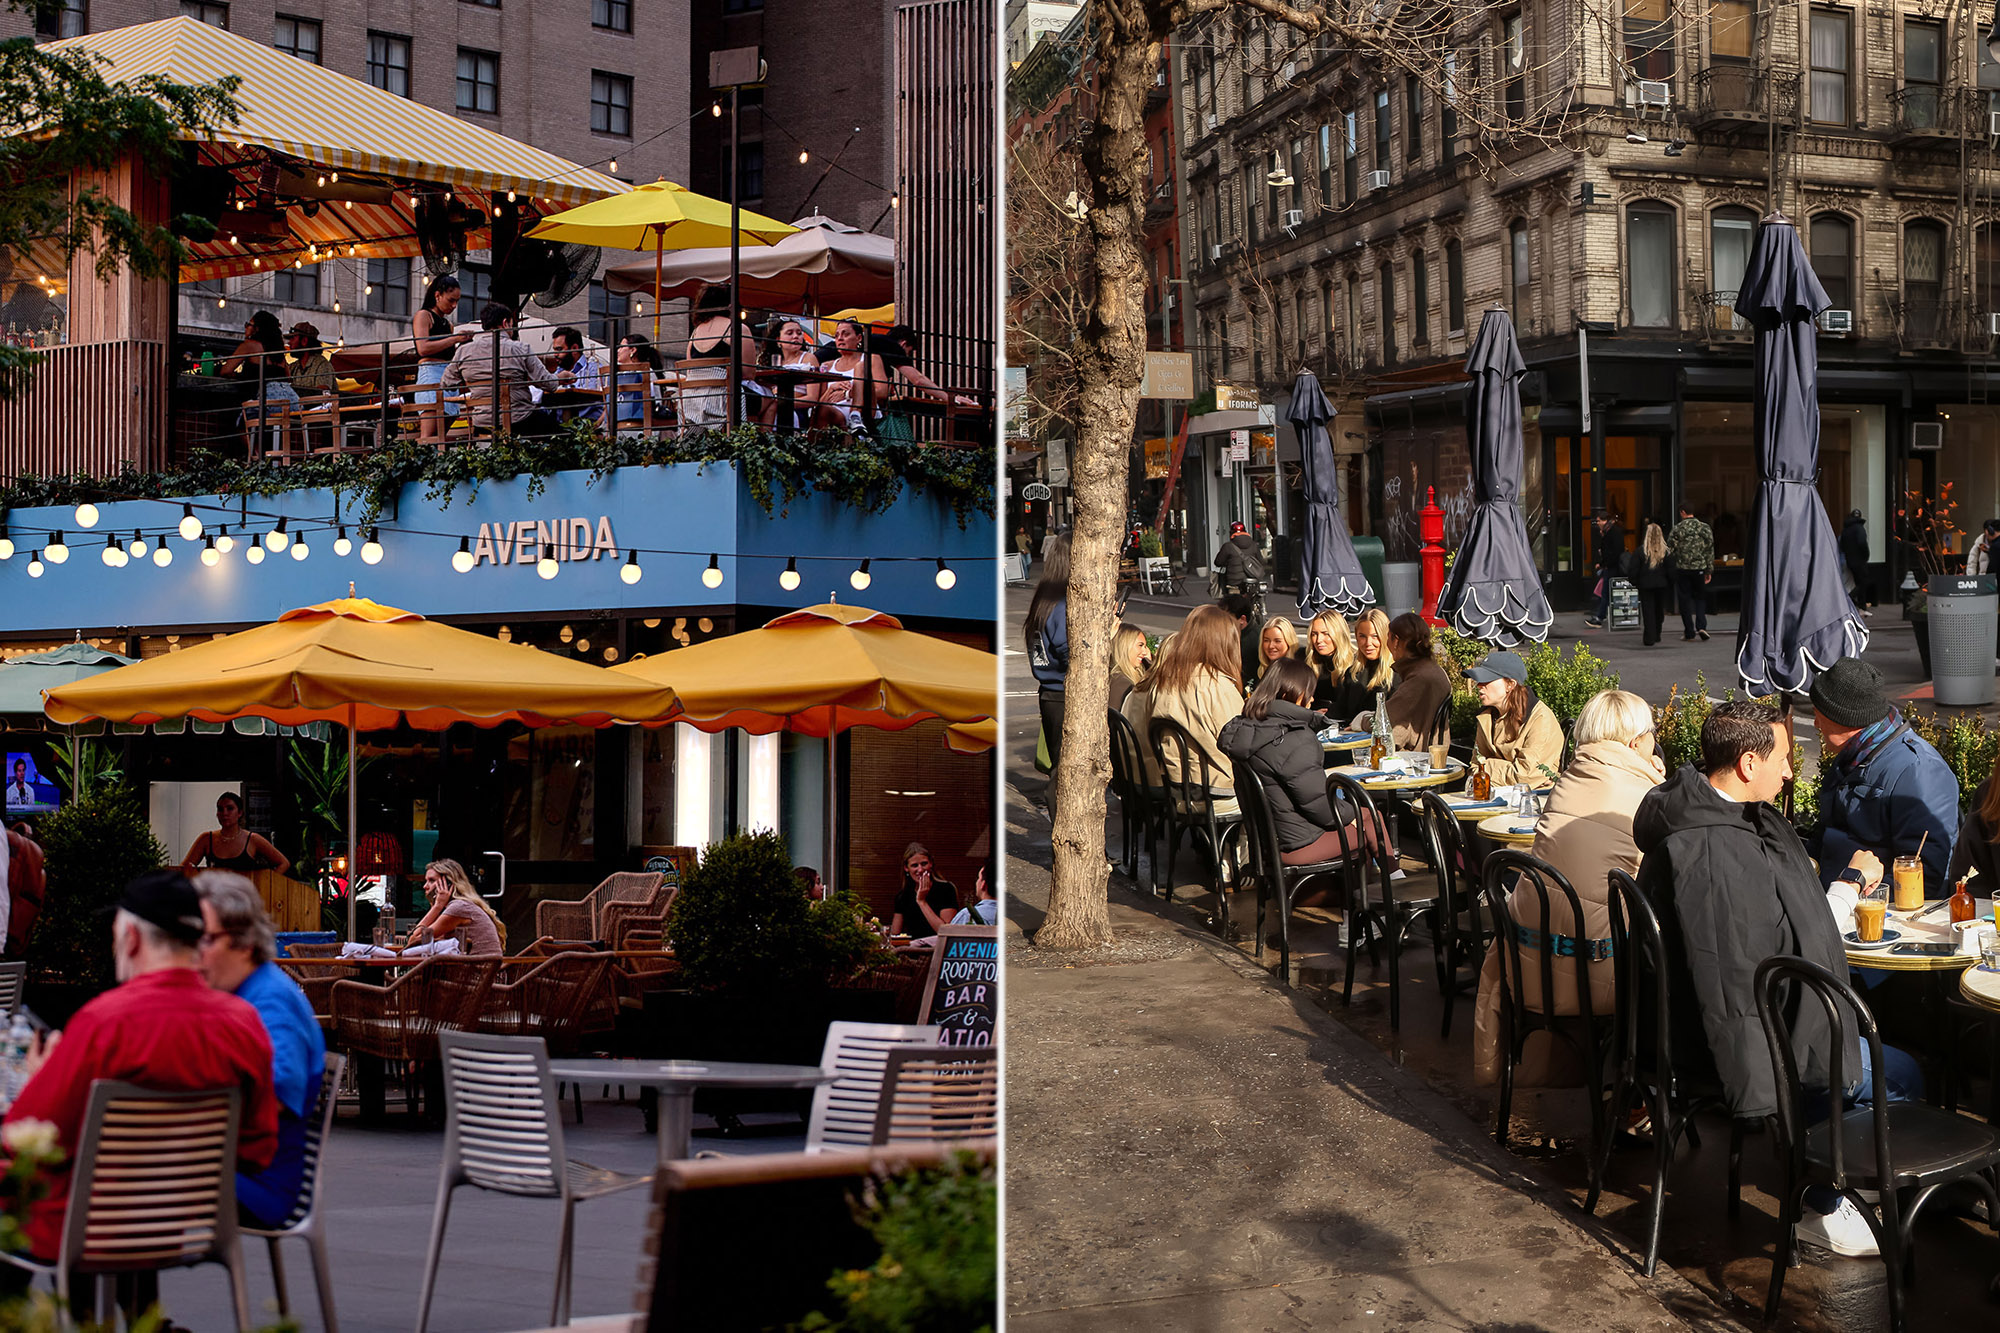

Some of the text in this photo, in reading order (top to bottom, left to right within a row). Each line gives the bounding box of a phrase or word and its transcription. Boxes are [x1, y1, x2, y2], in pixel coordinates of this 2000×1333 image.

[474, 515, 619, 566] AVENIDA
[945, 985, 986, 1007] BAR
[963, 1008, 978, 1026] &
[939, 1028, 989, 1048] ATIO
